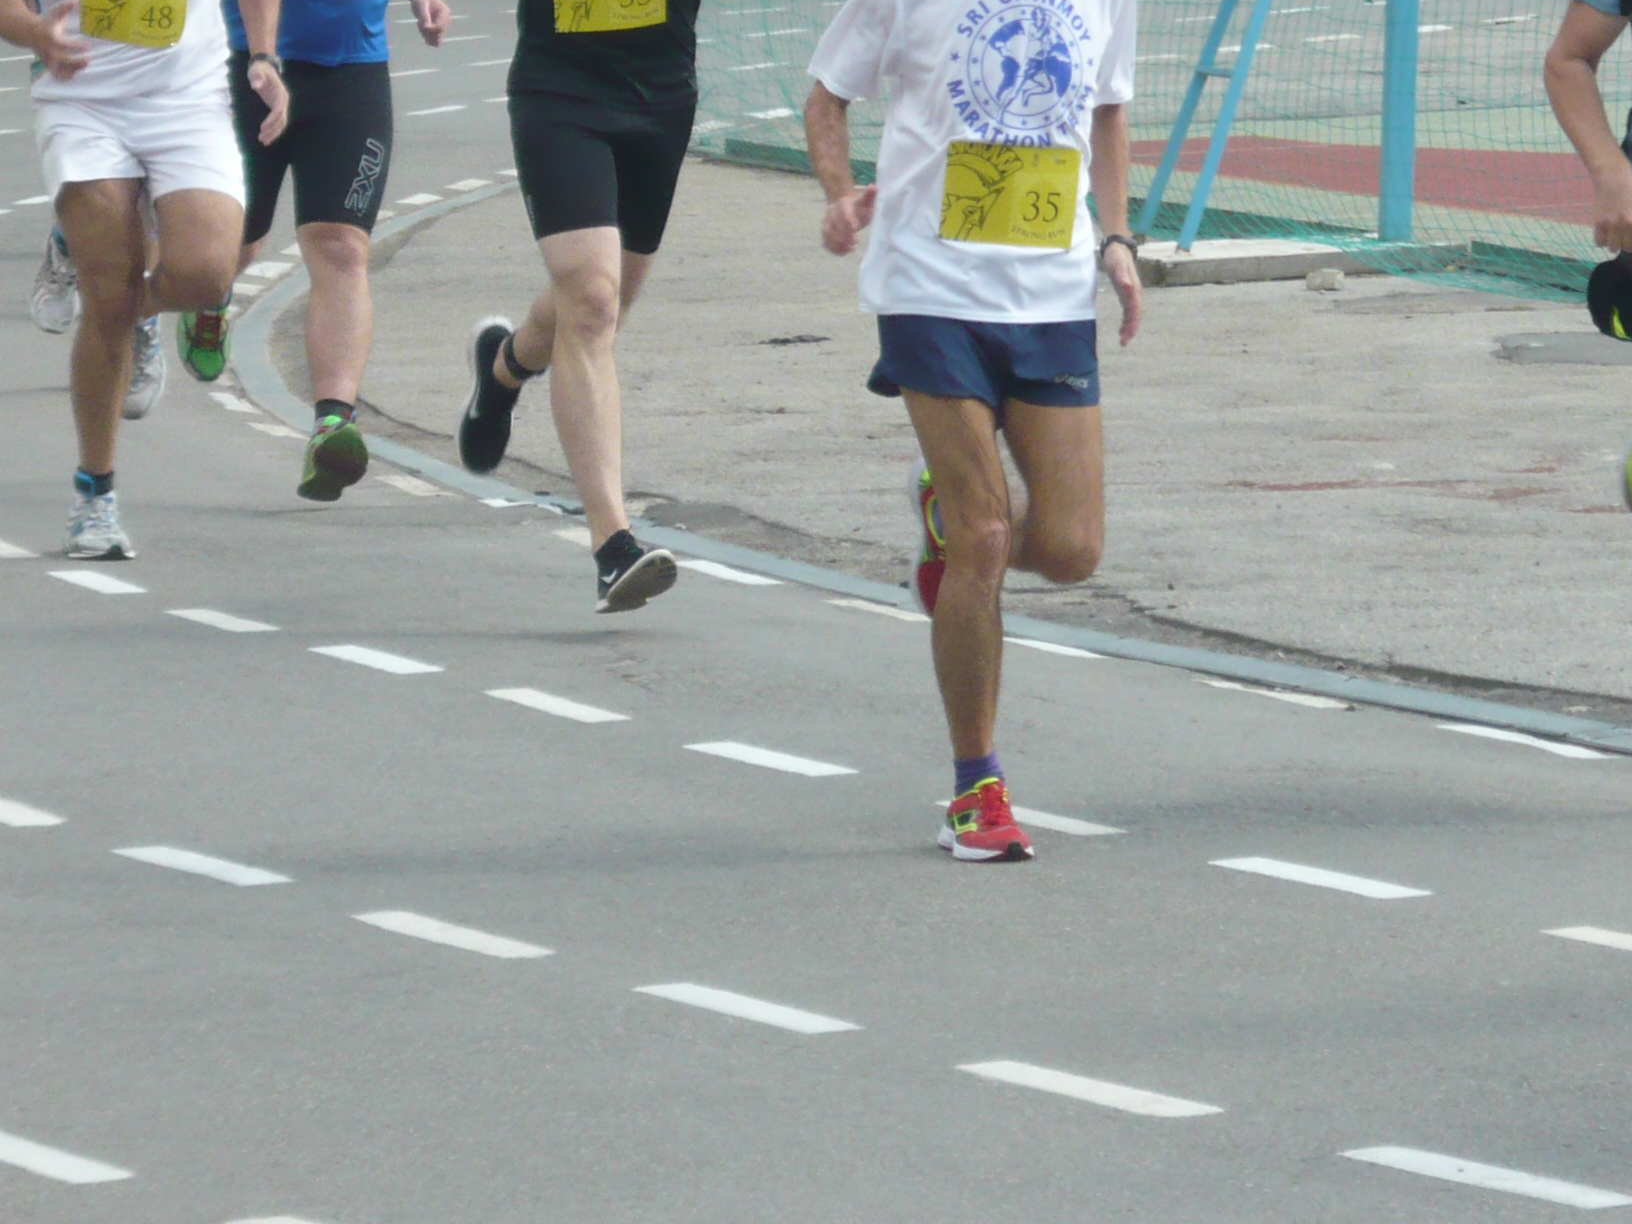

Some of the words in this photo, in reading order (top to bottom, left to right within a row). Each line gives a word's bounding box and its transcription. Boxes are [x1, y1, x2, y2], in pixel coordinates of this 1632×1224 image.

[140, 5, 174, 30] 48
[956, 0, 990, 38] SRI
[946, 78, 1052, 147] MARATHON
[1022, 190, 1062, 223] 35
[1010, 224, 1047, 241] STRONG
